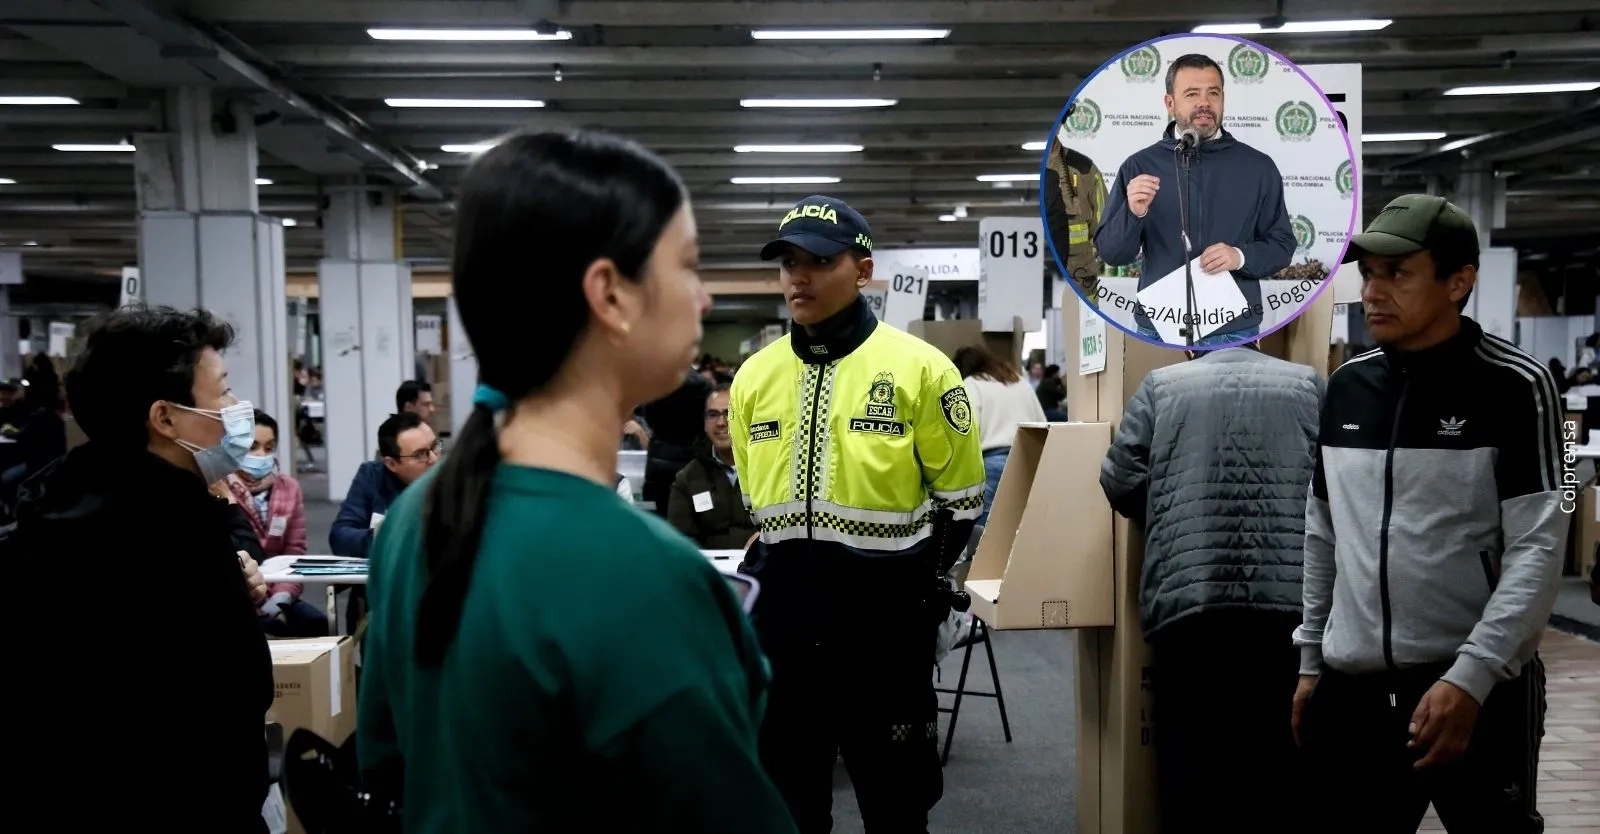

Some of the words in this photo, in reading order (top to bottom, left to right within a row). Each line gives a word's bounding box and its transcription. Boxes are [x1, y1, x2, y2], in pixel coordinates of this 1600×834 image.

[990, 230, 1038, 258] 013
[914, 264, 960, 275] ALIDA
[893, 273, 924, 295] 021
[1082, 335, 1097, 358] MESA
[1098, 334, 1103, 354] 5
[868, 405, 893, 417] ESCAR
[853, 420, 901, 436] POLICÍA
